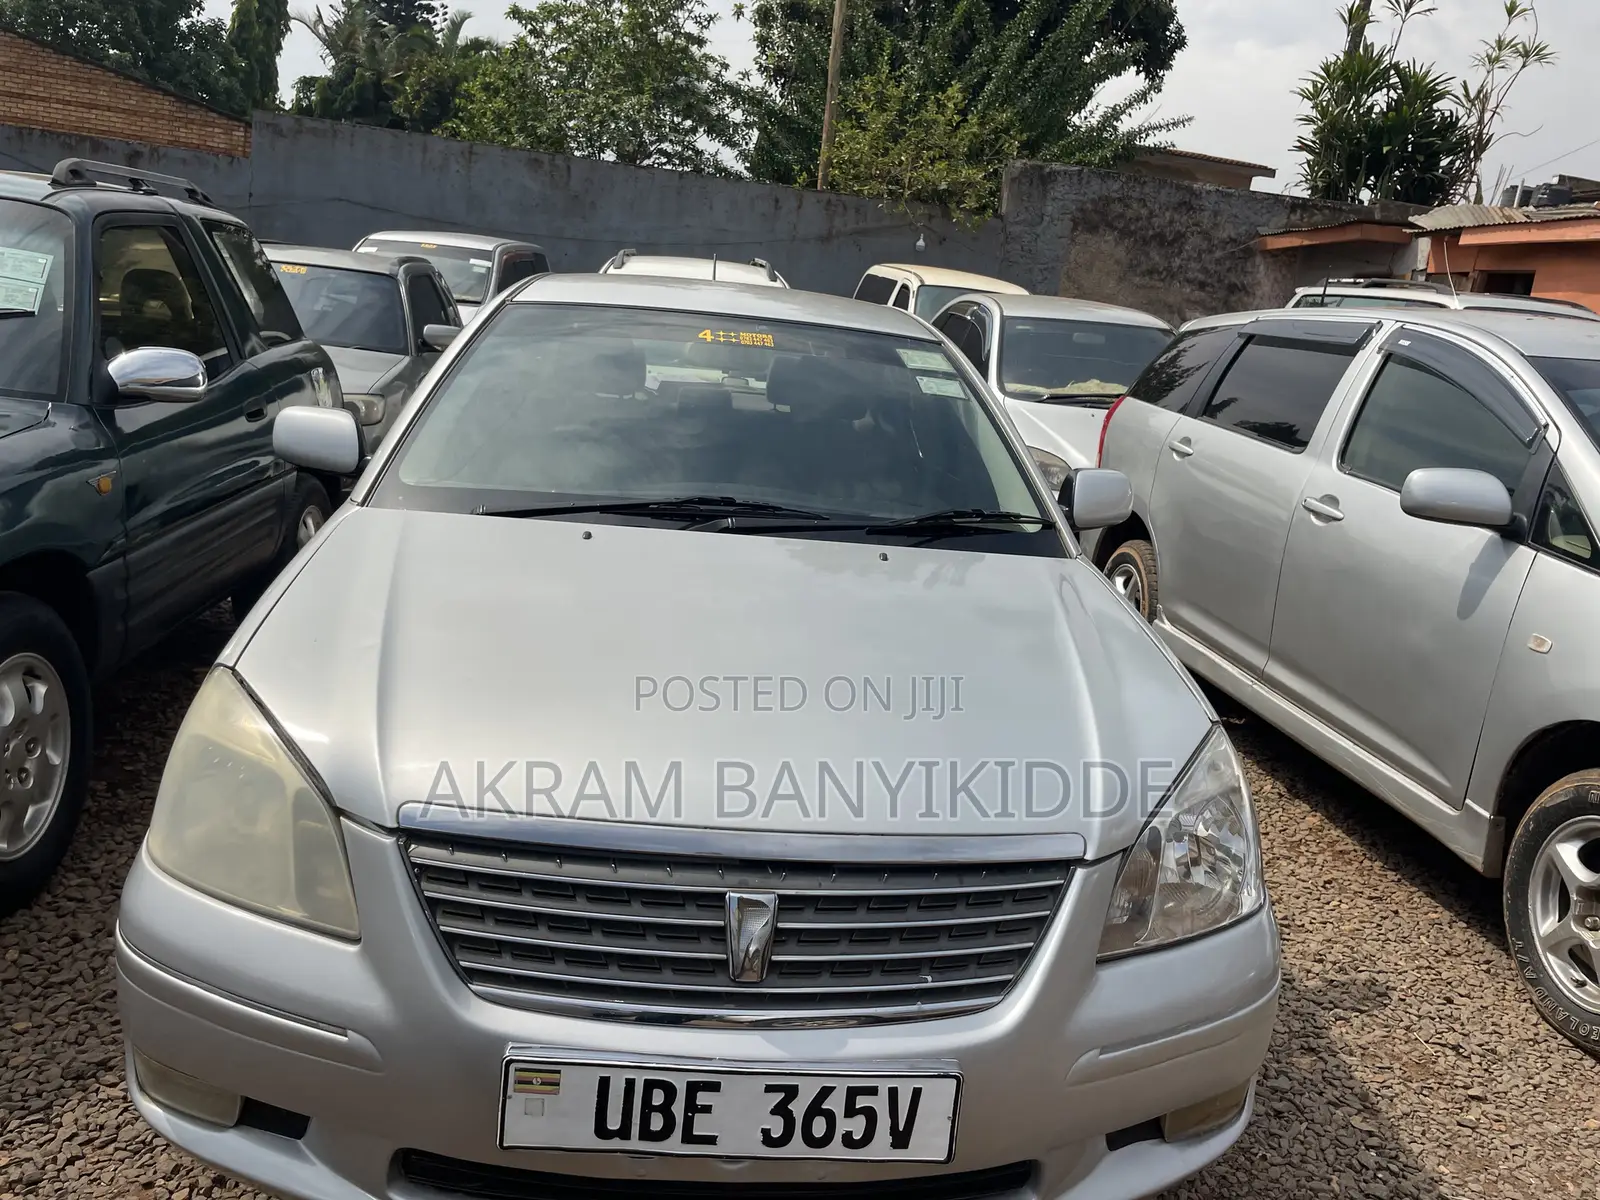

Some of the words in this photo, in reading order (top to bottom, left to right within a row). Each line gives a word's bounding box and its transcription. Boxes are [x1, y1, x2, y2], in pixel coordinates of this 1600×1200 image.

[698, 329, 714, 342] 4
[594, 1075, 721, 1145] UBE
[760, 1083, 923, 1150] 365V
